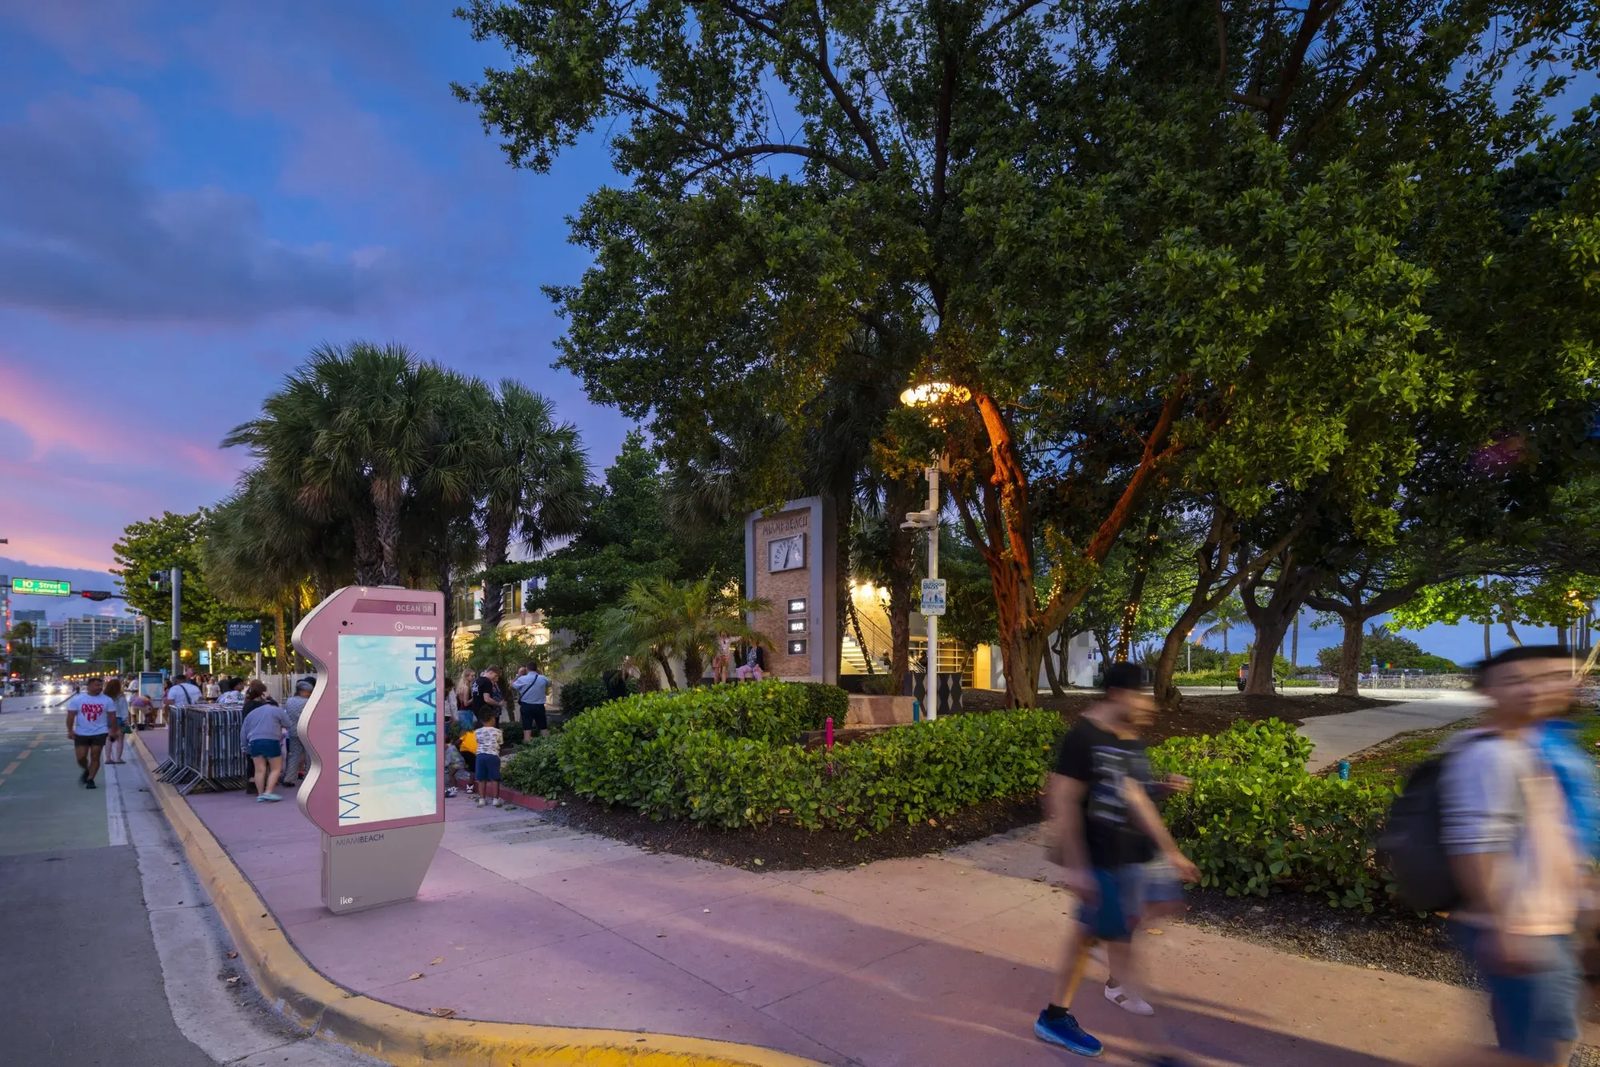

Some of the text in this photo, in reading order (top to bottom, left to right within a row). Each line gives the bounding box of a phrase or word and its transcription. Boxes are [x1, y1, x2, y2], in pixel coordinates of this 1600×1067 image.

[785, 515, 808, 531] BEACH
[23, 580, 33, 588] 10
[395, 604, 433, 613] OCEAN DR
[791, 622, 804, 631] MAR
[415, 643, 437, 746] BEACH
[338, 717, 360, 819] MIAMI
[340, 896, 353, 905] ike
